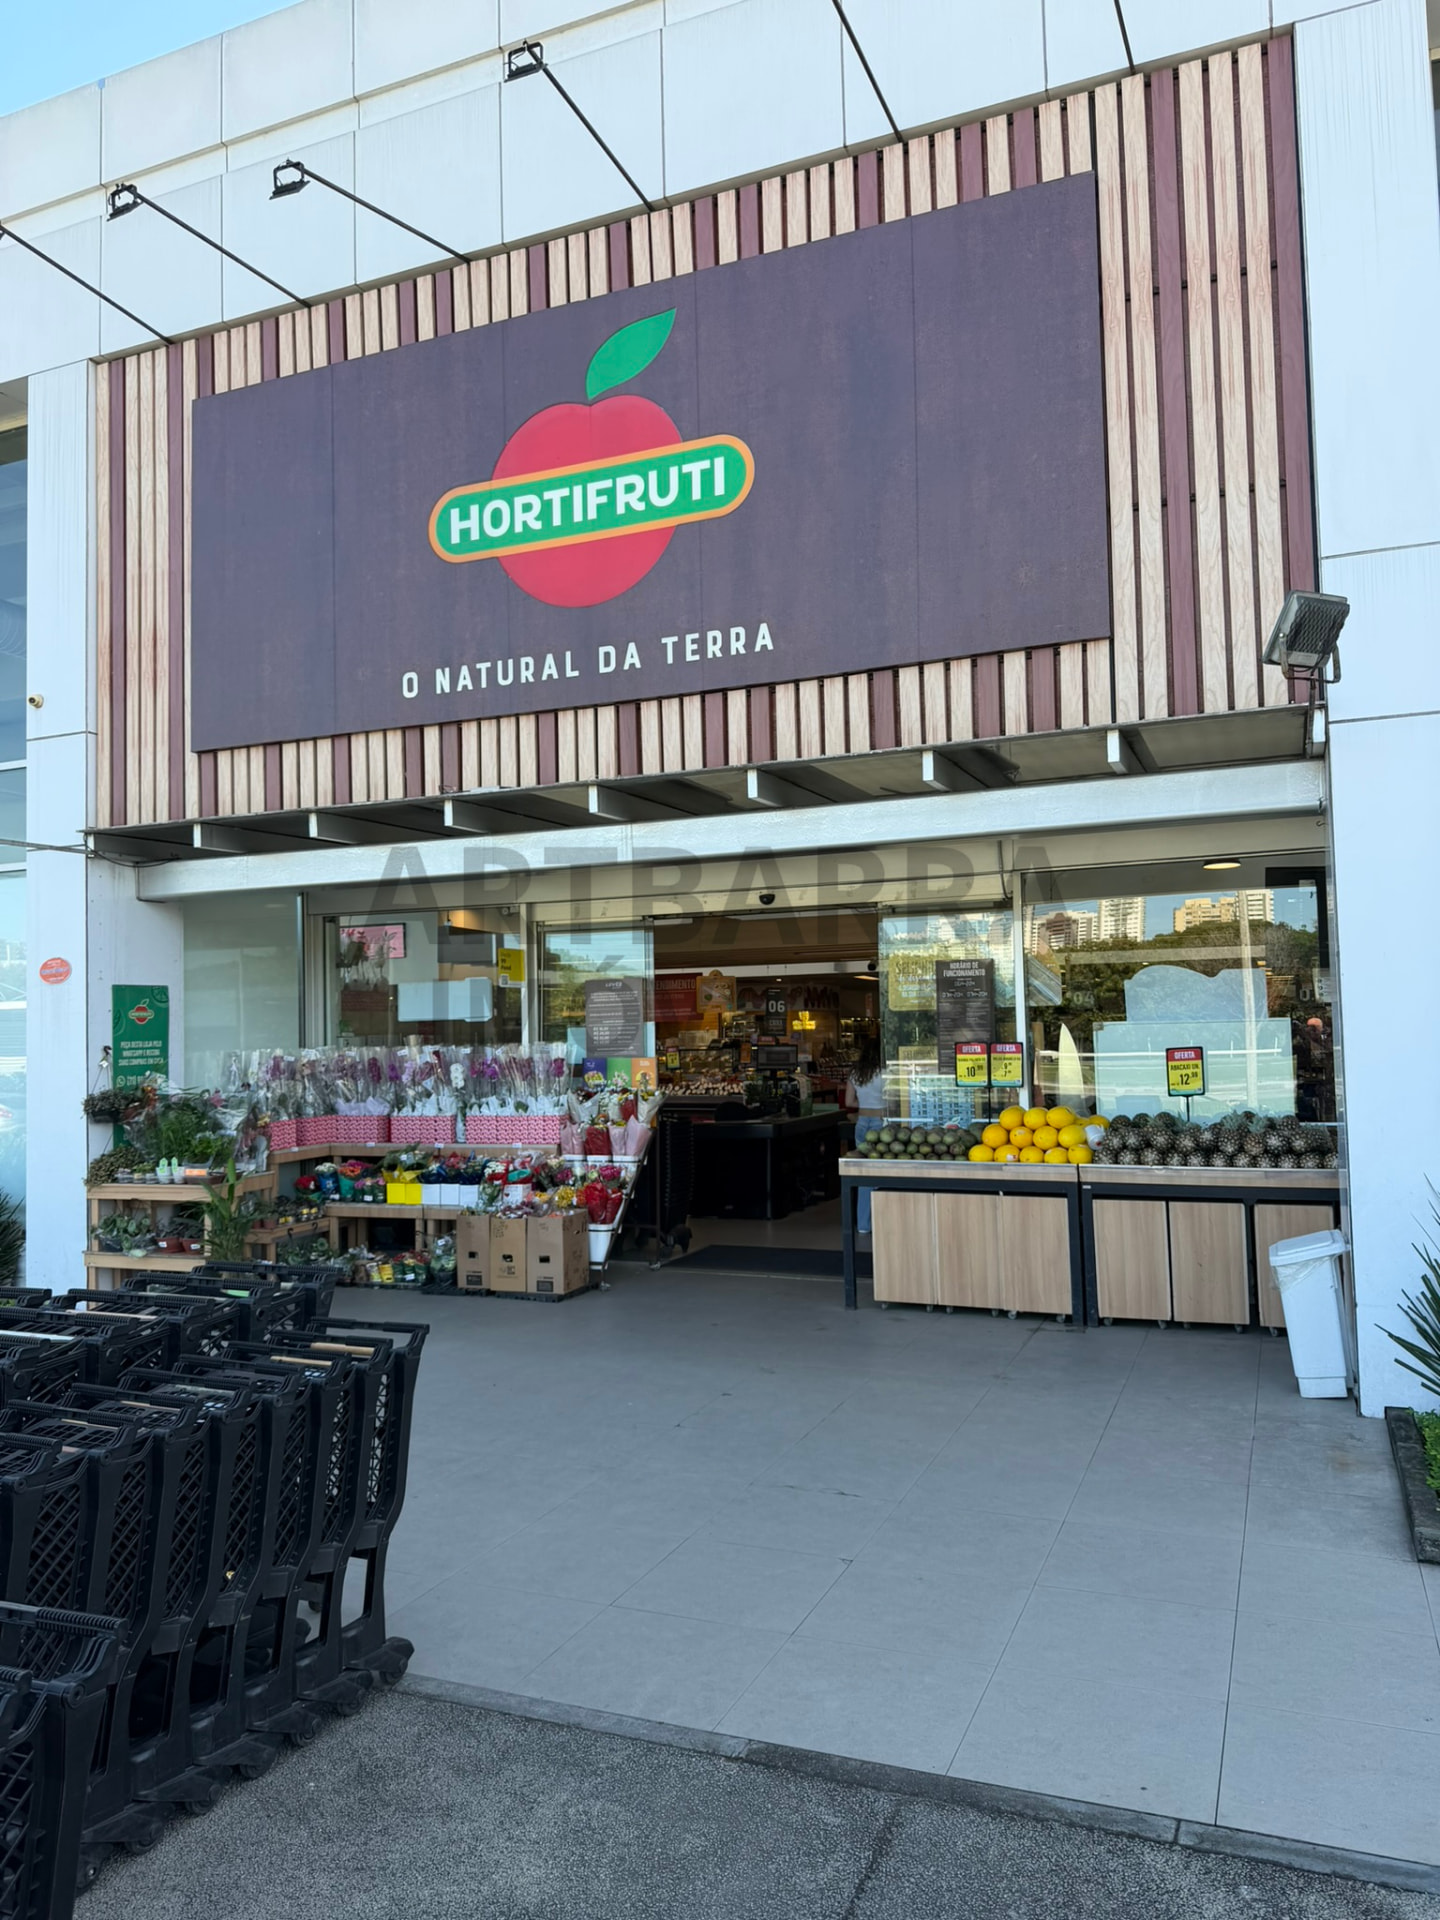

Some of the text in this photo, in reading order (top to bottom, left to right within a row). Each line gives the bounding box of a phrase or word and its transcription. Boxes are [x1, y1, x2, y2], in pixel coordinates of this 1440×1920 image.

[450, 456, 726, 545] HORTIFRUTI
[402, 622, 774, 698] O NATURAL DA TERRA
[768, 1000, 786, 1013] 06
